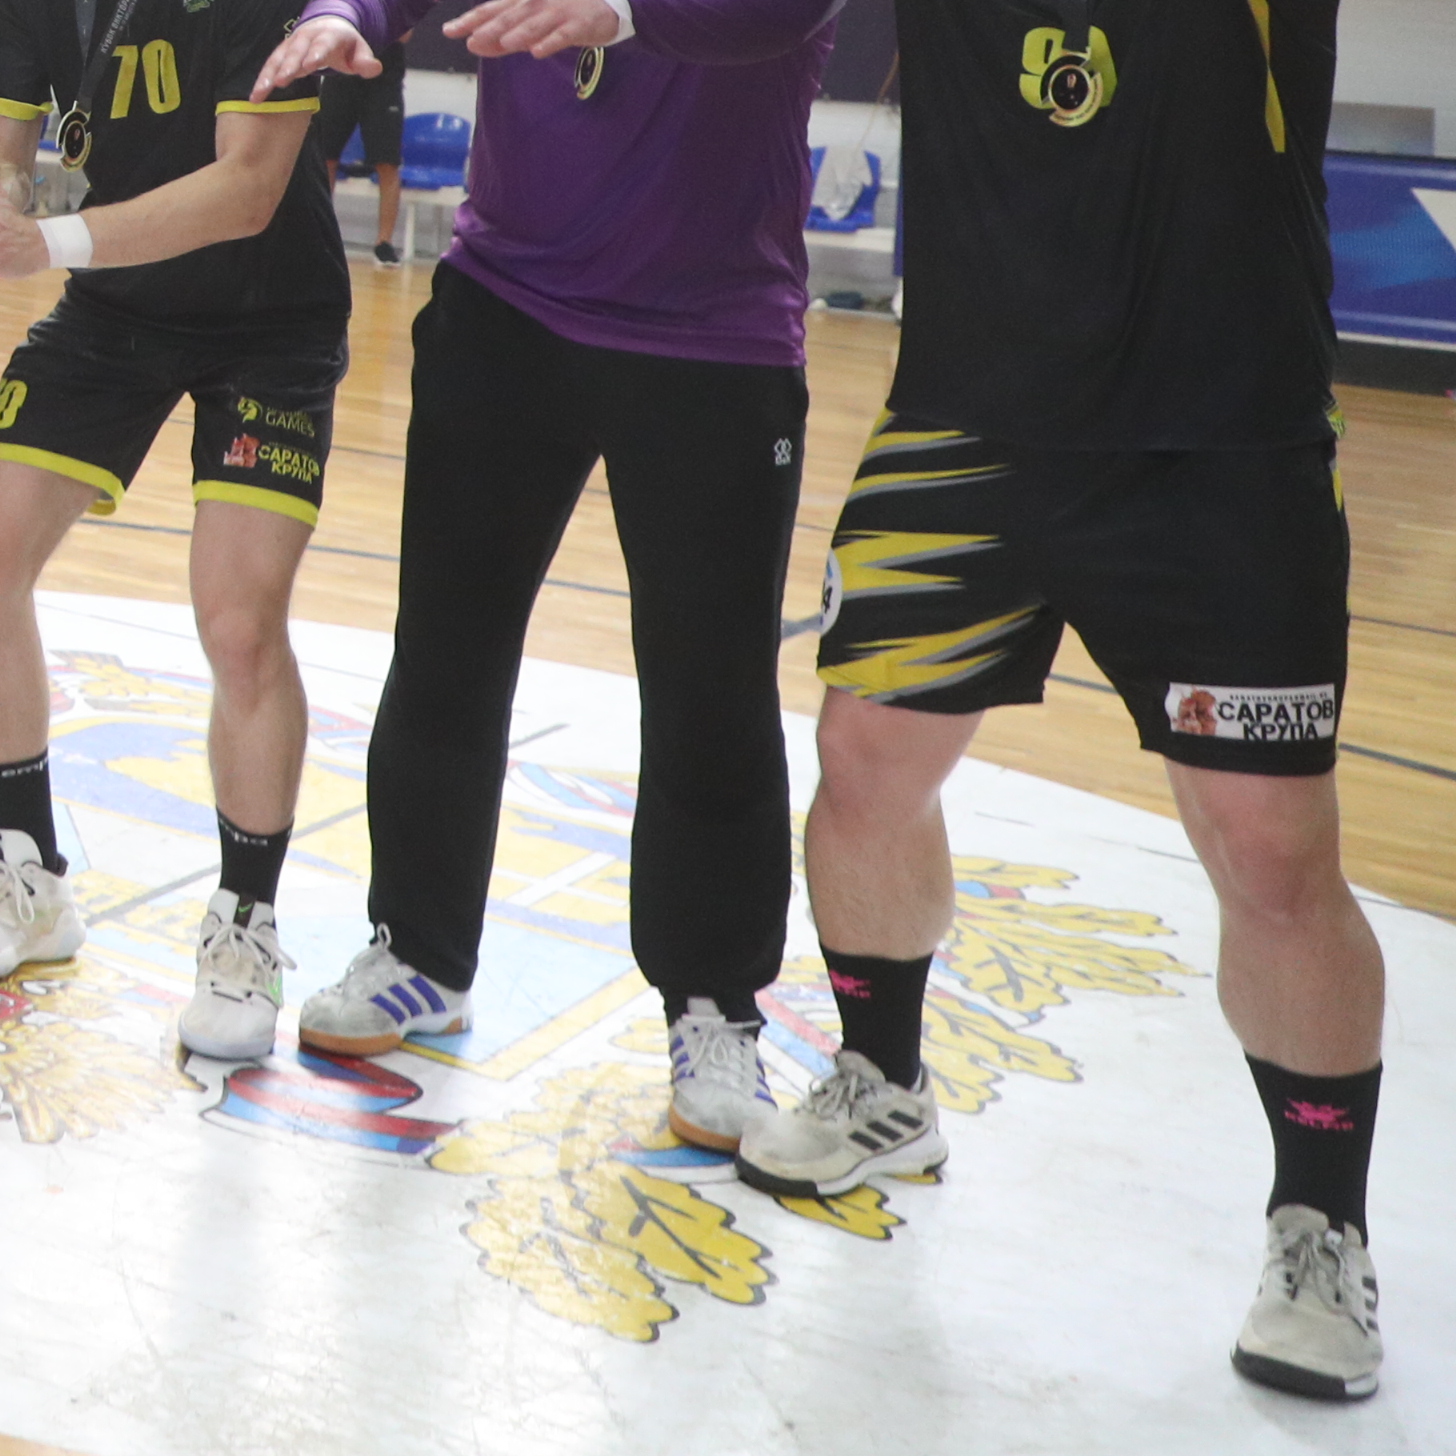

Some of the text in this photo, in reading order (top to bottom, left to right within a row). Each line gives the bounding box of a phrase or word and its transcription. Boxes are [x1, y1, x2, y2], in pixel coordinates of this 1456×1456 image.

[110, 38, 182, 119] 70
[271, 460, 313, 485] КРУПА
[1217, 700, 1334, 723] САРАТОВ
[1242, 722, 1319, 741] КРУПА
